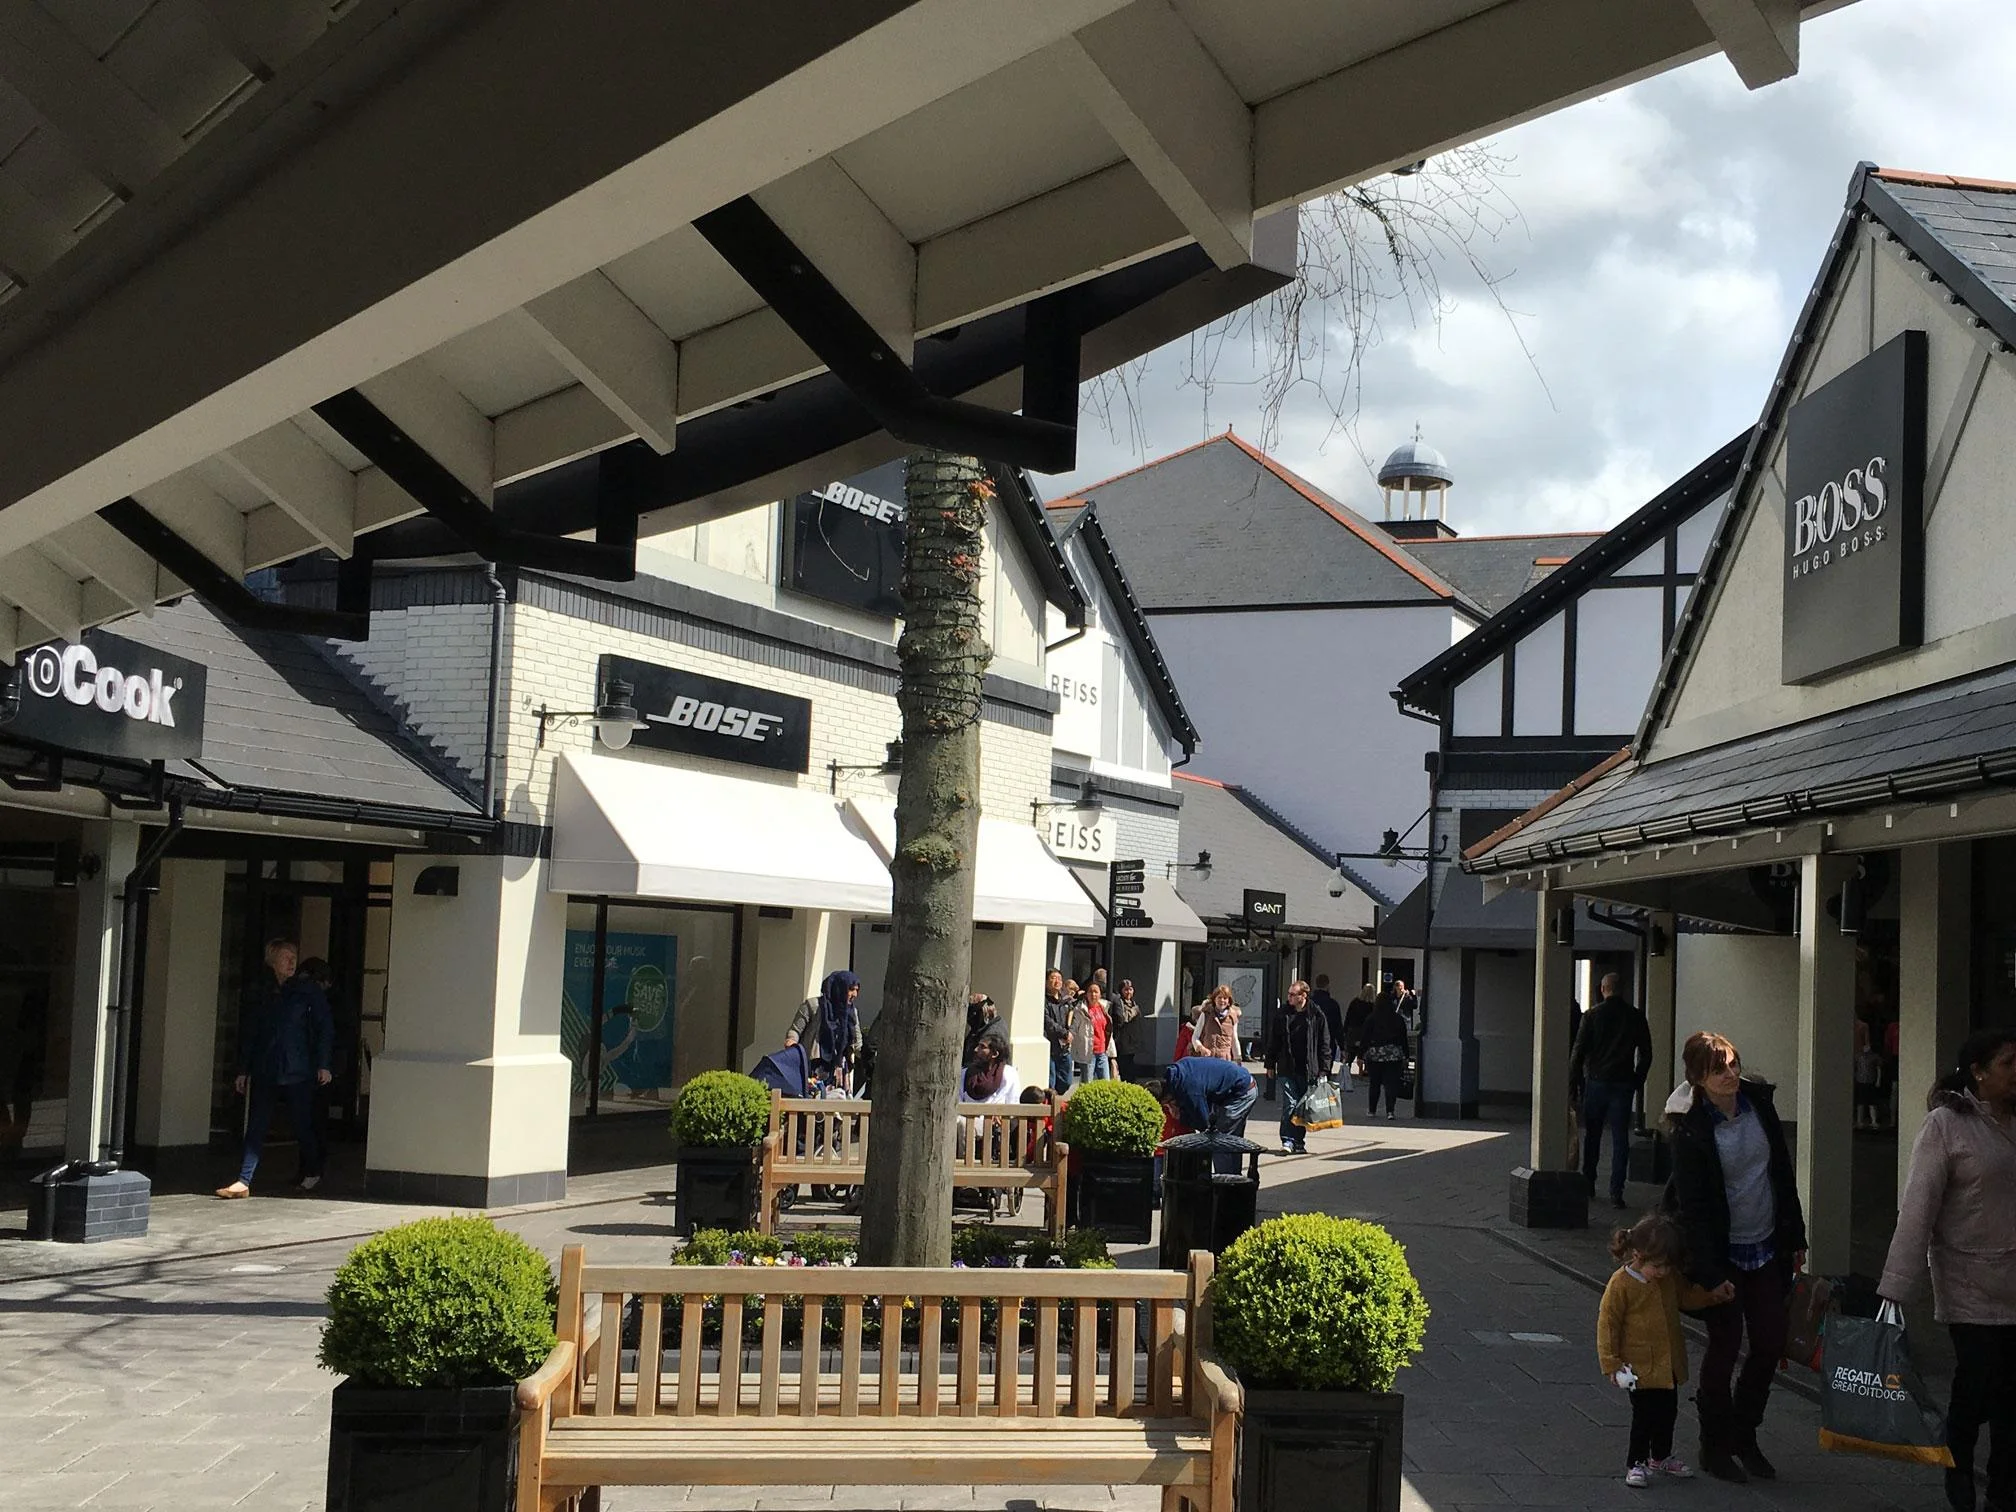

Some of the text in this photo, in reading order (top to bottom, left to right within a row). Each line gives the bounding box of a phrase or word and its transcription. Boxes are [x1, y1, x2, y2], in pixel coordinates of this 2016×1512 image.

[811, 481, 904, 524] BOSE
[1793, 457, 1887, 557] BOSS
[1792, 525, 1885, 579] HUGO BOSS
[1051, 674, 1098, 706] REISS
[646, 696, 784, 741] BOSE
[1047, 821, 1102, 852] EISS
[1115, 918, 1139, 927] GUCCI
[1254, 902, 1282, 914] GANT
[575, 943, 597, 954] ENJO
[1831, 1379, 1858, 1393] GREAT
[1834, 1366, 1883, 1387] REGATTA
